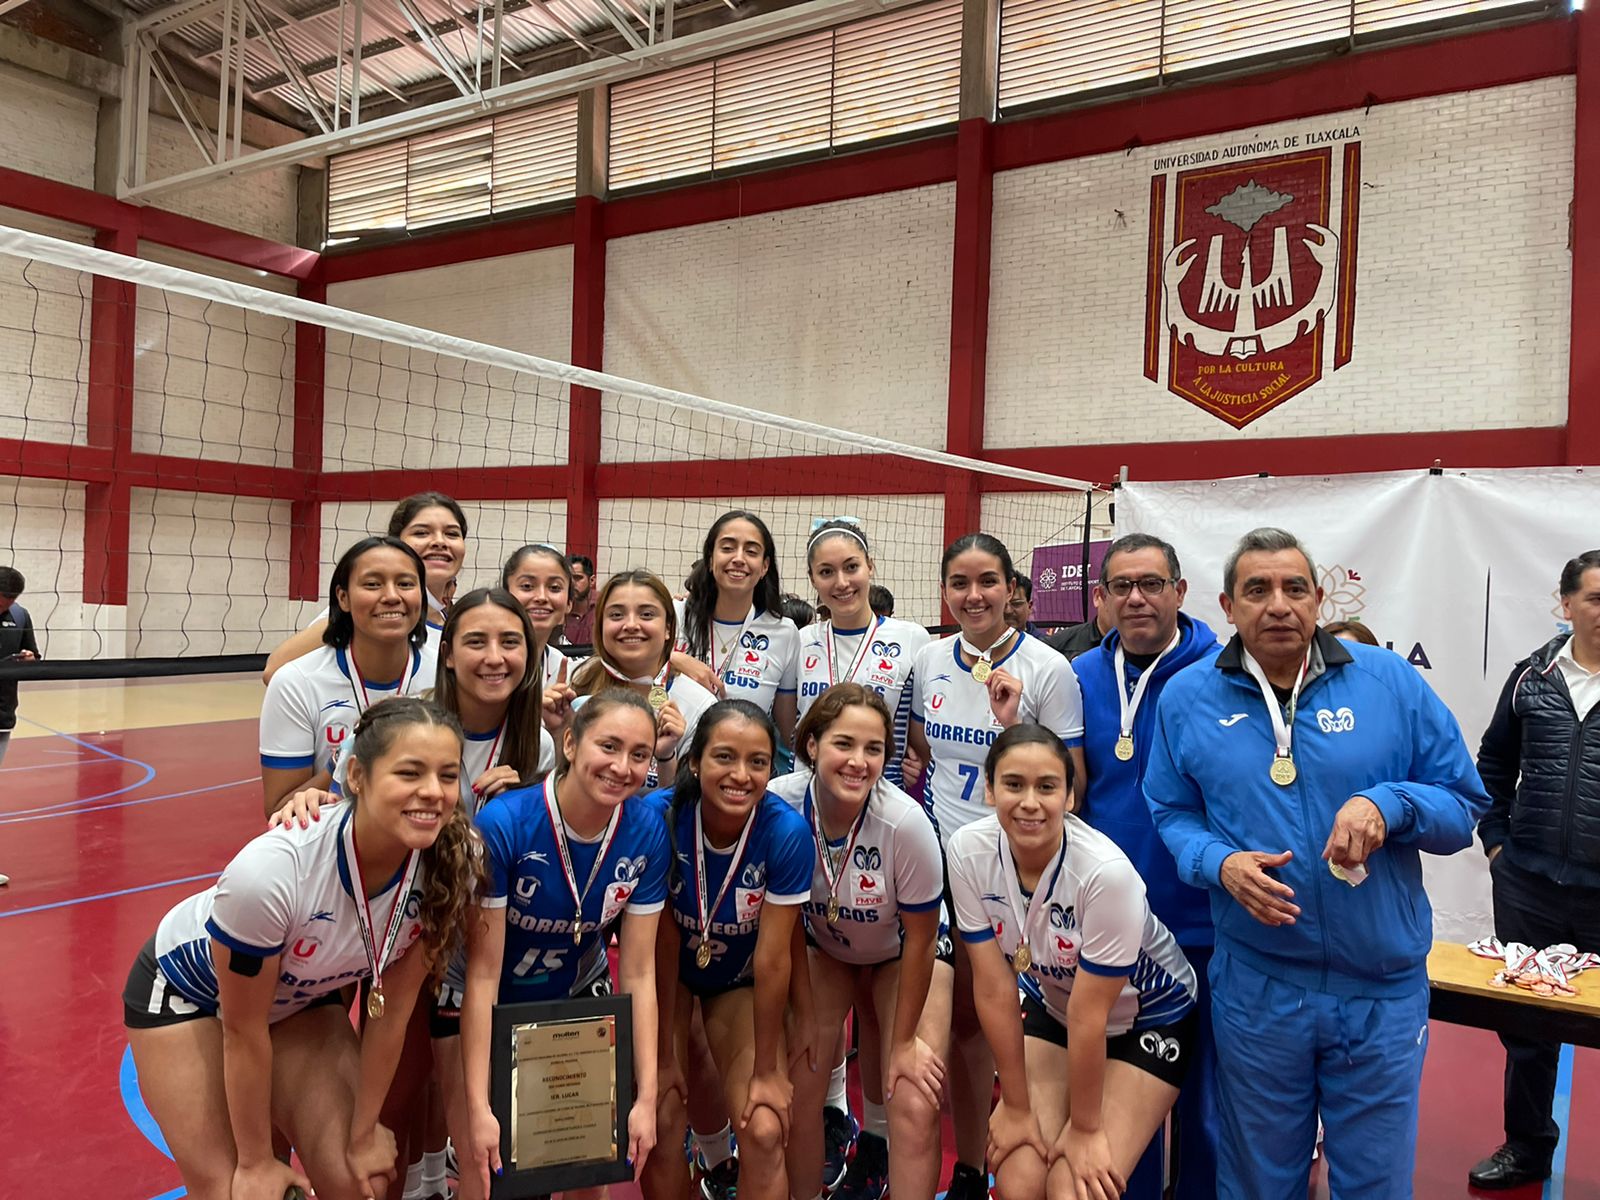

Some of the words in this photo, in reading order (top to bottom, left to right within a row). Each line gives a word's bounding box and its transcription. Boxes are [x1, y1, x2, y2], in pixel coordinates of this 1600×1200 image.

[1154, 149, 1218, 170] UNIVERSIDAD
[1222, 139, 1279, 159] AUTONOMA
[1284, 136, 1299, 148] DE
[1305, 126, 1360, 145] TLAXCALA
[1198, 365, 1215, 374] POR
[1219, 364, 1231, 373] LA
[1235, 361, 1284, 372] CULTURA
[1193, 377, 1202, 386] A
[1200, 382, 1211, 397] LA
[1210, 390, 1259, 405] JUSTICIA
[1259, 373, 1291, 399] SOCIAL
[926, 720, 999, 747] BORREGO
[959, 764, 979, 801] 7
[513, 948, 568, 977] 15
